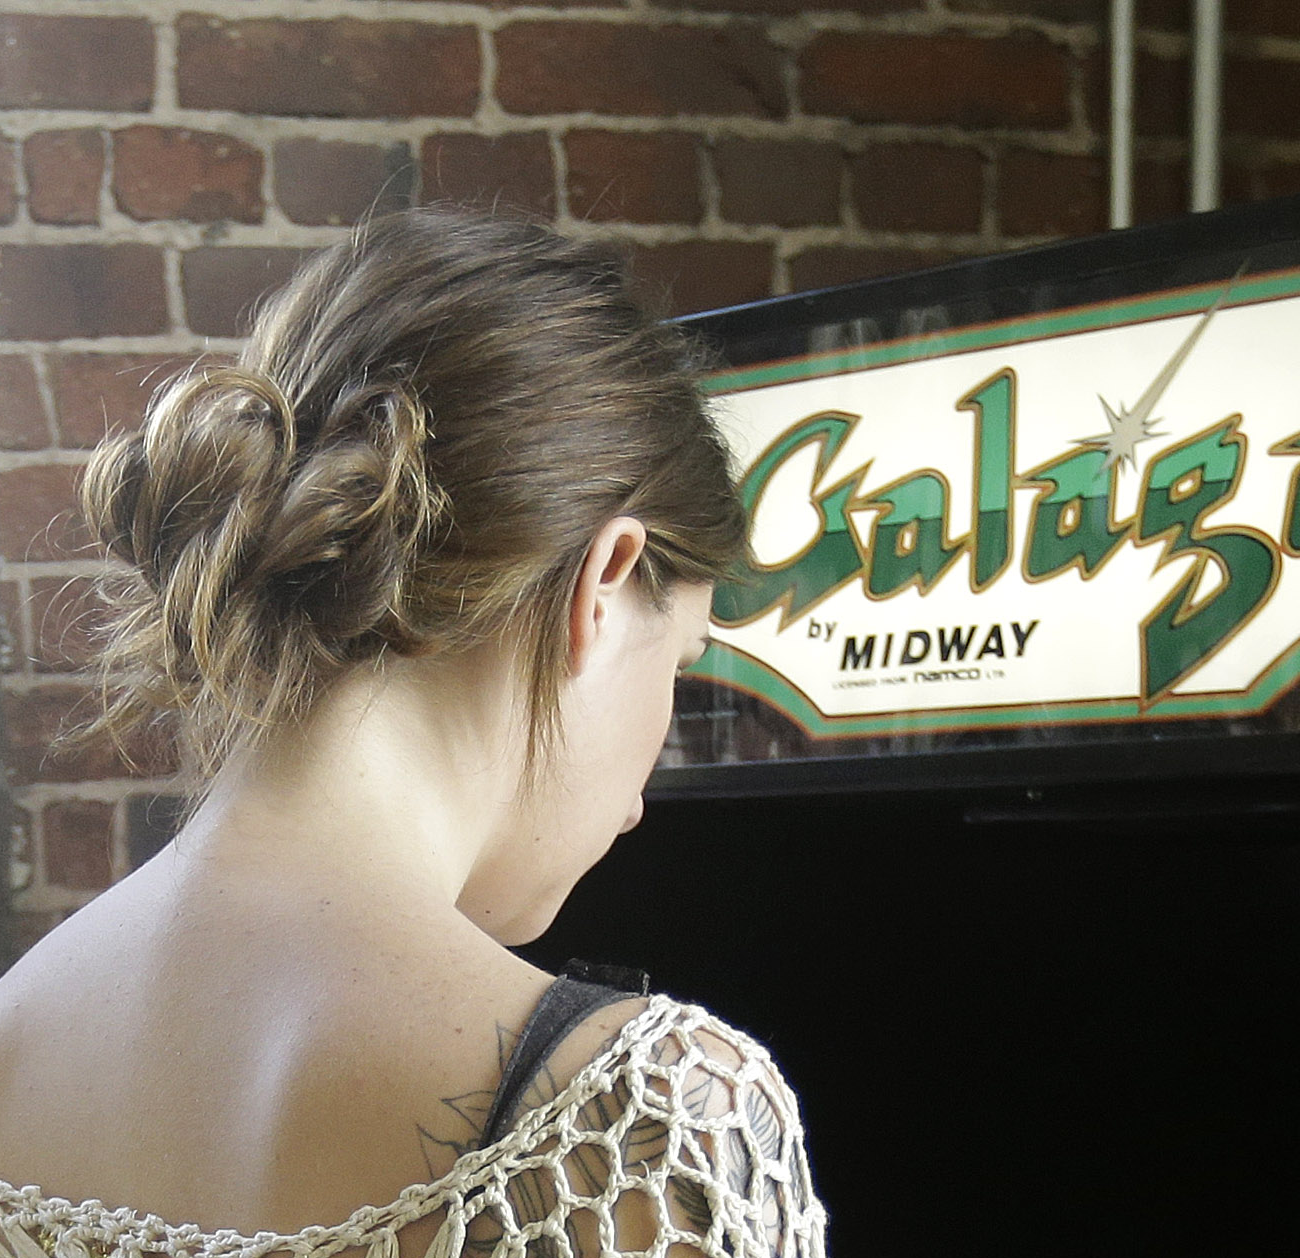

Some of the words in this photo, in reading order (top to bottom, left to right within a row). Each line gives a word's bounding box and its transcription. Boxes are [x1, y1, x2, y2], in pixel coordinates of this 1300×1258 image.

[807, 617, 837, 642] by
[839, 620, 1040, 670] MIDWAY
[914, 667, 981, 683] namco
